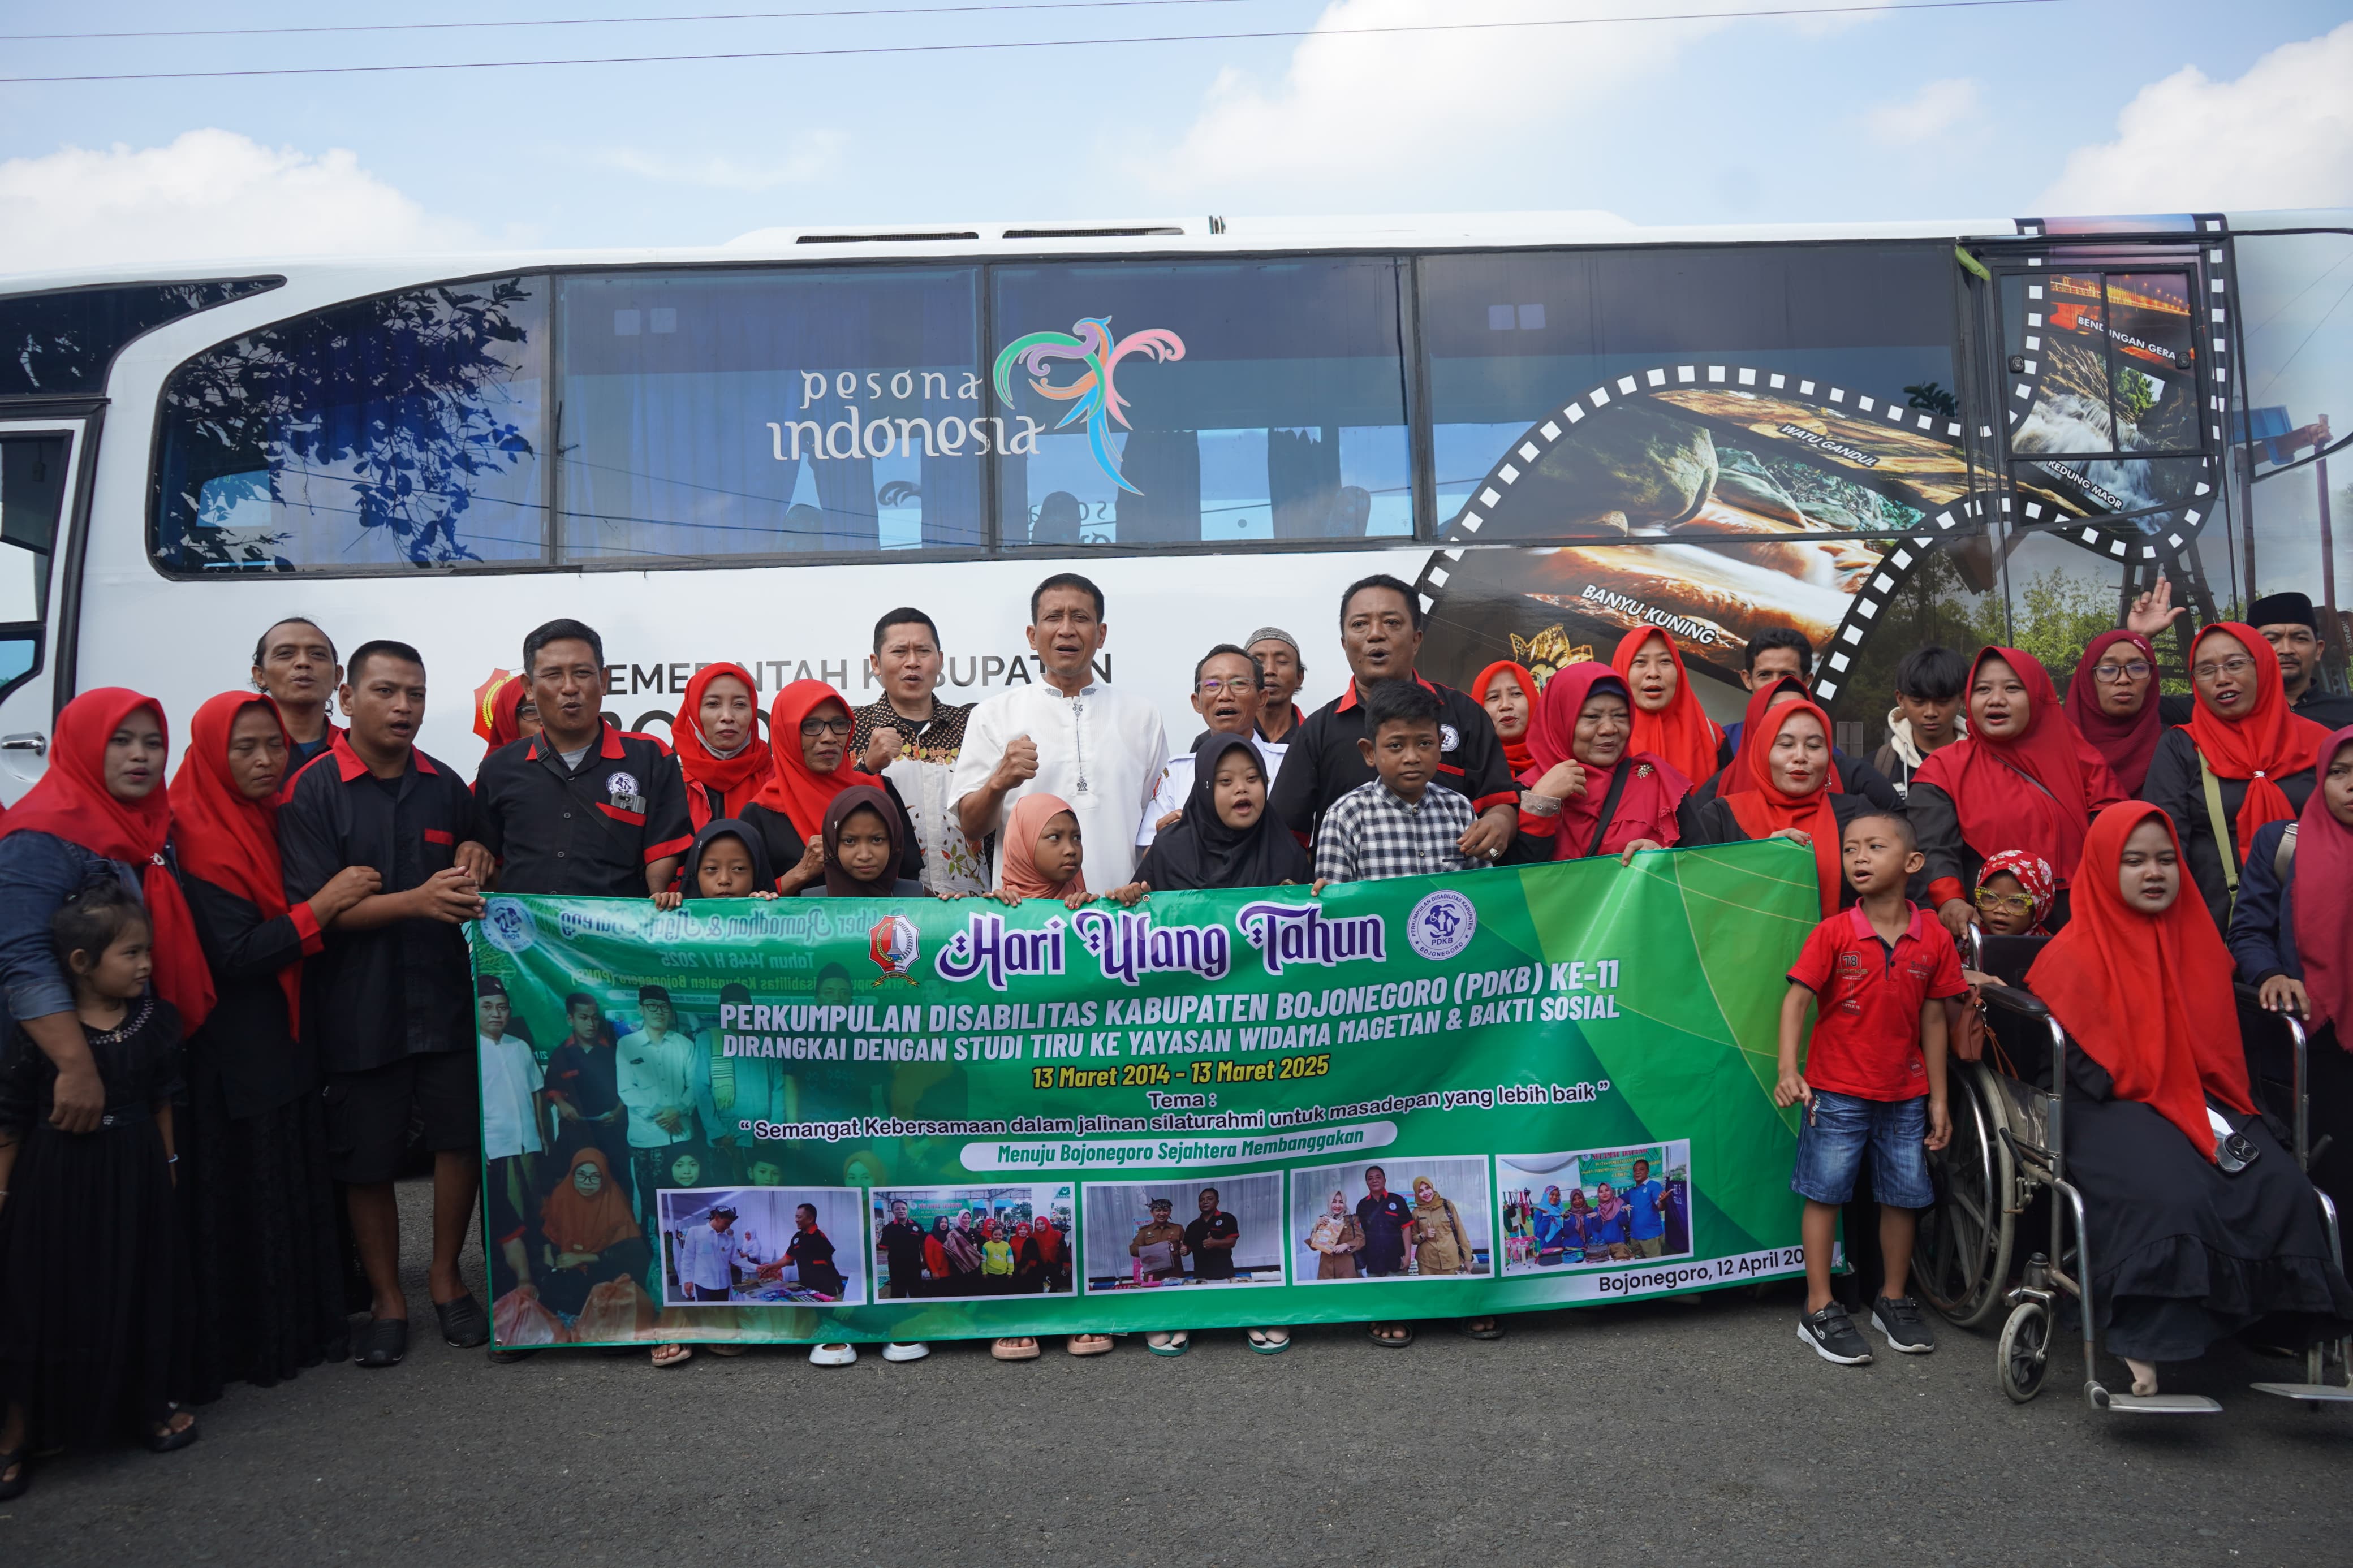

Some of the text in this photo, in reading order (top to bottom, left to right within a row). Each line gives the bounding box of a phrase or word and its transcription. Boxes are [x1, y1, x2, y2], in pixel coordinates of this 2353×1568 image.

[2148, 344, 2175, 360] GERA
[801, 369, 982, 408] pesona
[767, 407, 1045, 460] indonesia
[1781, 424, 1878, 467] WATU GANDUL
[2048, 460, 2123, 510] KEDUNG MAOR
[1582, 584, 1716, 644] BANYU KUNING
[607, 659, 847, 694] EMENTAH
[1411, 893, 1473, 937] PERKUMPULAN DISABILITAS KABUPATEN
[937, 901, 1384, 990] Hari Ulang Tahun
[1420, 941, 1463, 957] BOJONEGORO
[1432, 937, 1453, 946] PDKB
[1842, 955, 1858, 967] 78
[720, 960, 1619, 1033] PERKUMPULAN DISABILITAS KABUPATEN BOJONEGORO (PDKB) KE-11
[723, 995, 1620, 1062] DIRANGKAI DENGAN STUDI TIRU KE YAYASAN WIDAMA MAGETAN & BAKTI SOSIAL
[1032, 1066, 1054, 1089] 13
[1059, 1065, 1117, 1088] Maret
[1122, 1064, 1170, 1086] 2014
[1191, 1062, 1212, 1084] 13
[1217, 1058, 1276, 1082] Maret
[1279, 1054, 1330, 1078] 2025
[755, 1120, 859, 1142] Semangat
[863, 1116, 1005, 1137] Kebersamaan
[1011, 1117, 1073, 1133] dalam
[1076, 1115, 1146, 1136] jalinan
[1150, 1110, 1265, 1131] silaturahmi
[1270, 1105, 1326, 1126] untuk
[1329, 1089, 1440, 1121] masadepan
[1442, 1086, 1494, 1109] yang
[1498, 1083, 1548, 1105] lebih
[1551, 1081, 1595, 1103] baik
[1149, 1092, 1205, 1109] Tema
[997, 1129, 1364, 1167] Menuju Bojonegoro Sejahtera Membanggakan
[1599, 1249, 1804, 1294] Bojonegoro, 12 April 20
